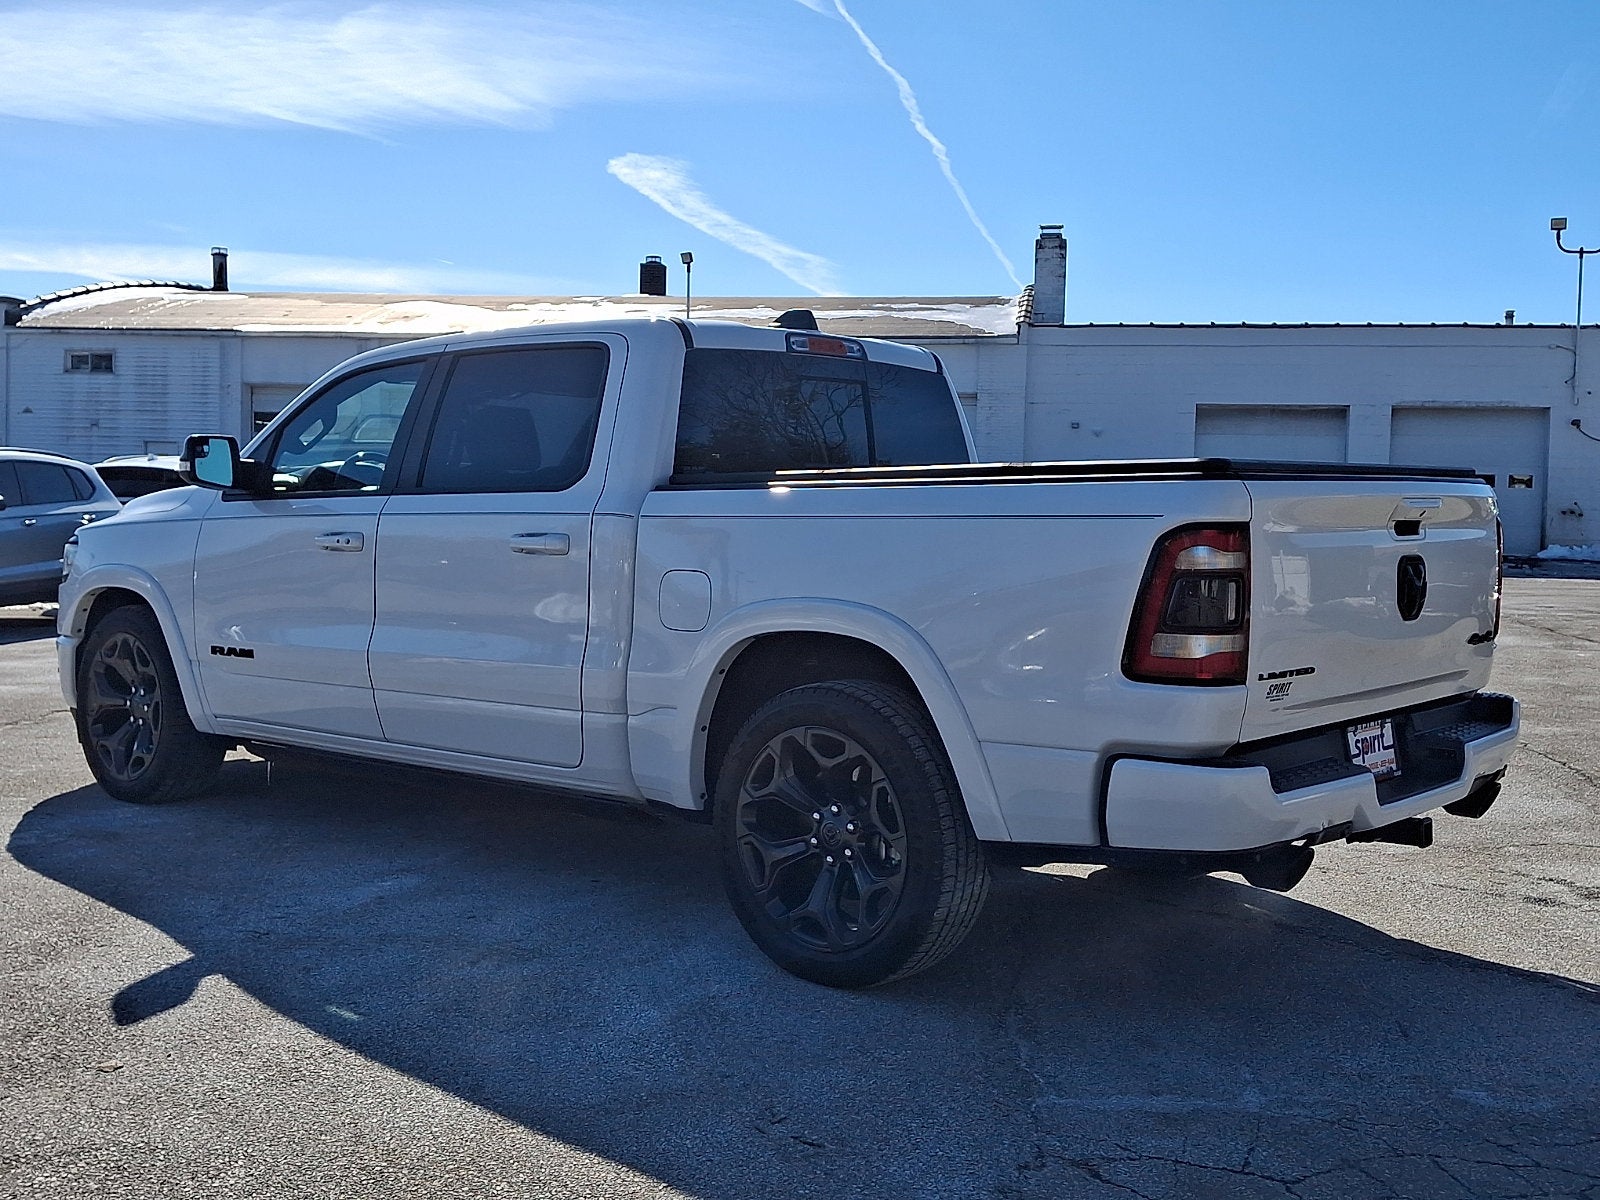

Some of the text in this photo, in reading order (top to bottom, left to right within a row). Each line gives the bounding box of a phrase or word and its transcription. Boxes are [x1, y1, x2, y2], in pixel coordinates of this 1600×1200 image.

[210, 645, 254, 659] RAM
[1258, 666, 1316, 681] LIMITED
[1266, 681, 1293, 695] SPIRIT
